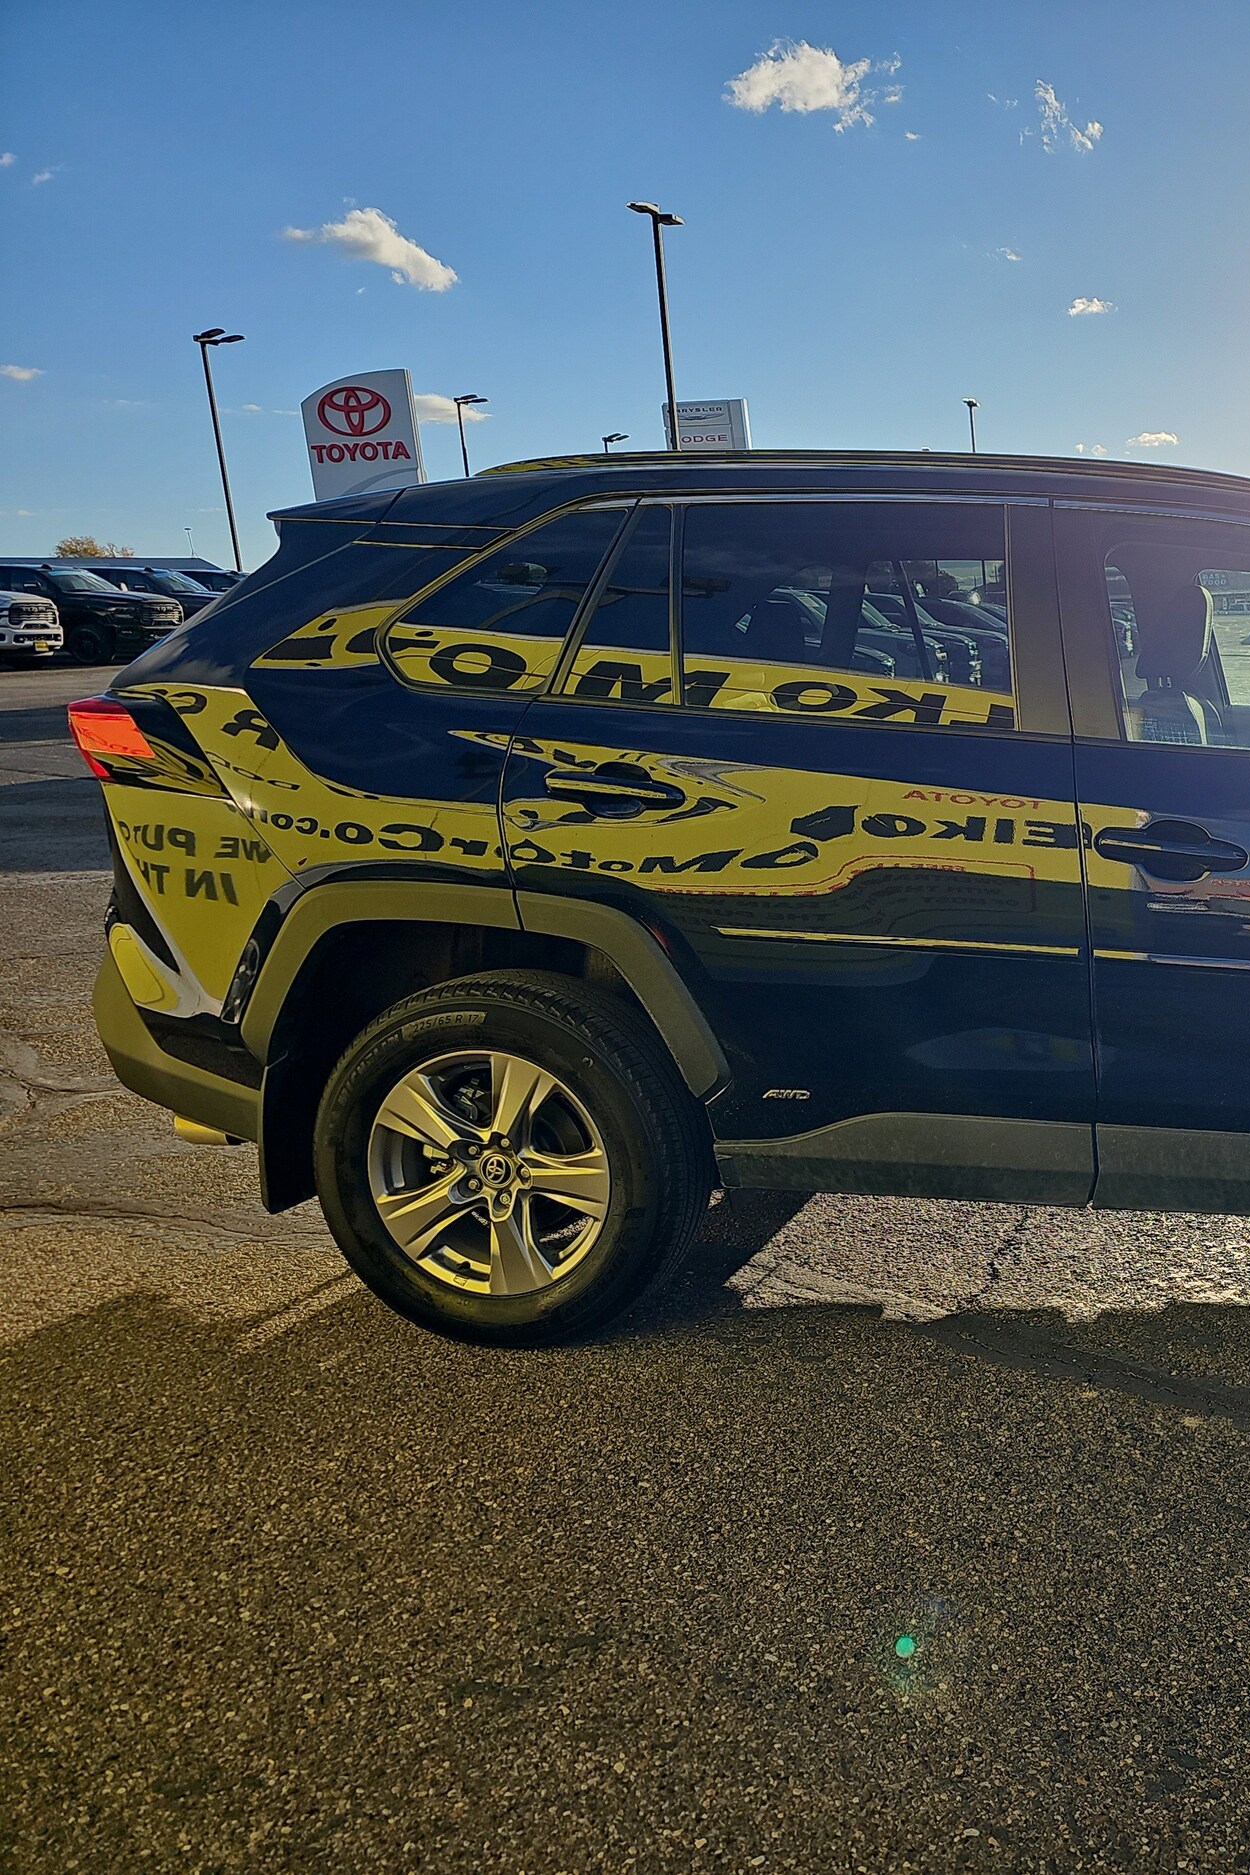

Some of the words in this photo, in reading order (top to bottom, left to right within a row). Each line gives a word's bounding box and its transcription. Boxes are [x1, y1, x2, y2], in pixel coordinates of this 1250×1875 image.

[680, 434, 728, 443] ODGE
[311, 440, 411, 464] TOYOTA
[412, 1014, 451, 1033] 225/65
[455, 1014, 463, 1024] R
[468, 1014, 479, 1023] 17
[762, 1089, 810, 1099] AWD
